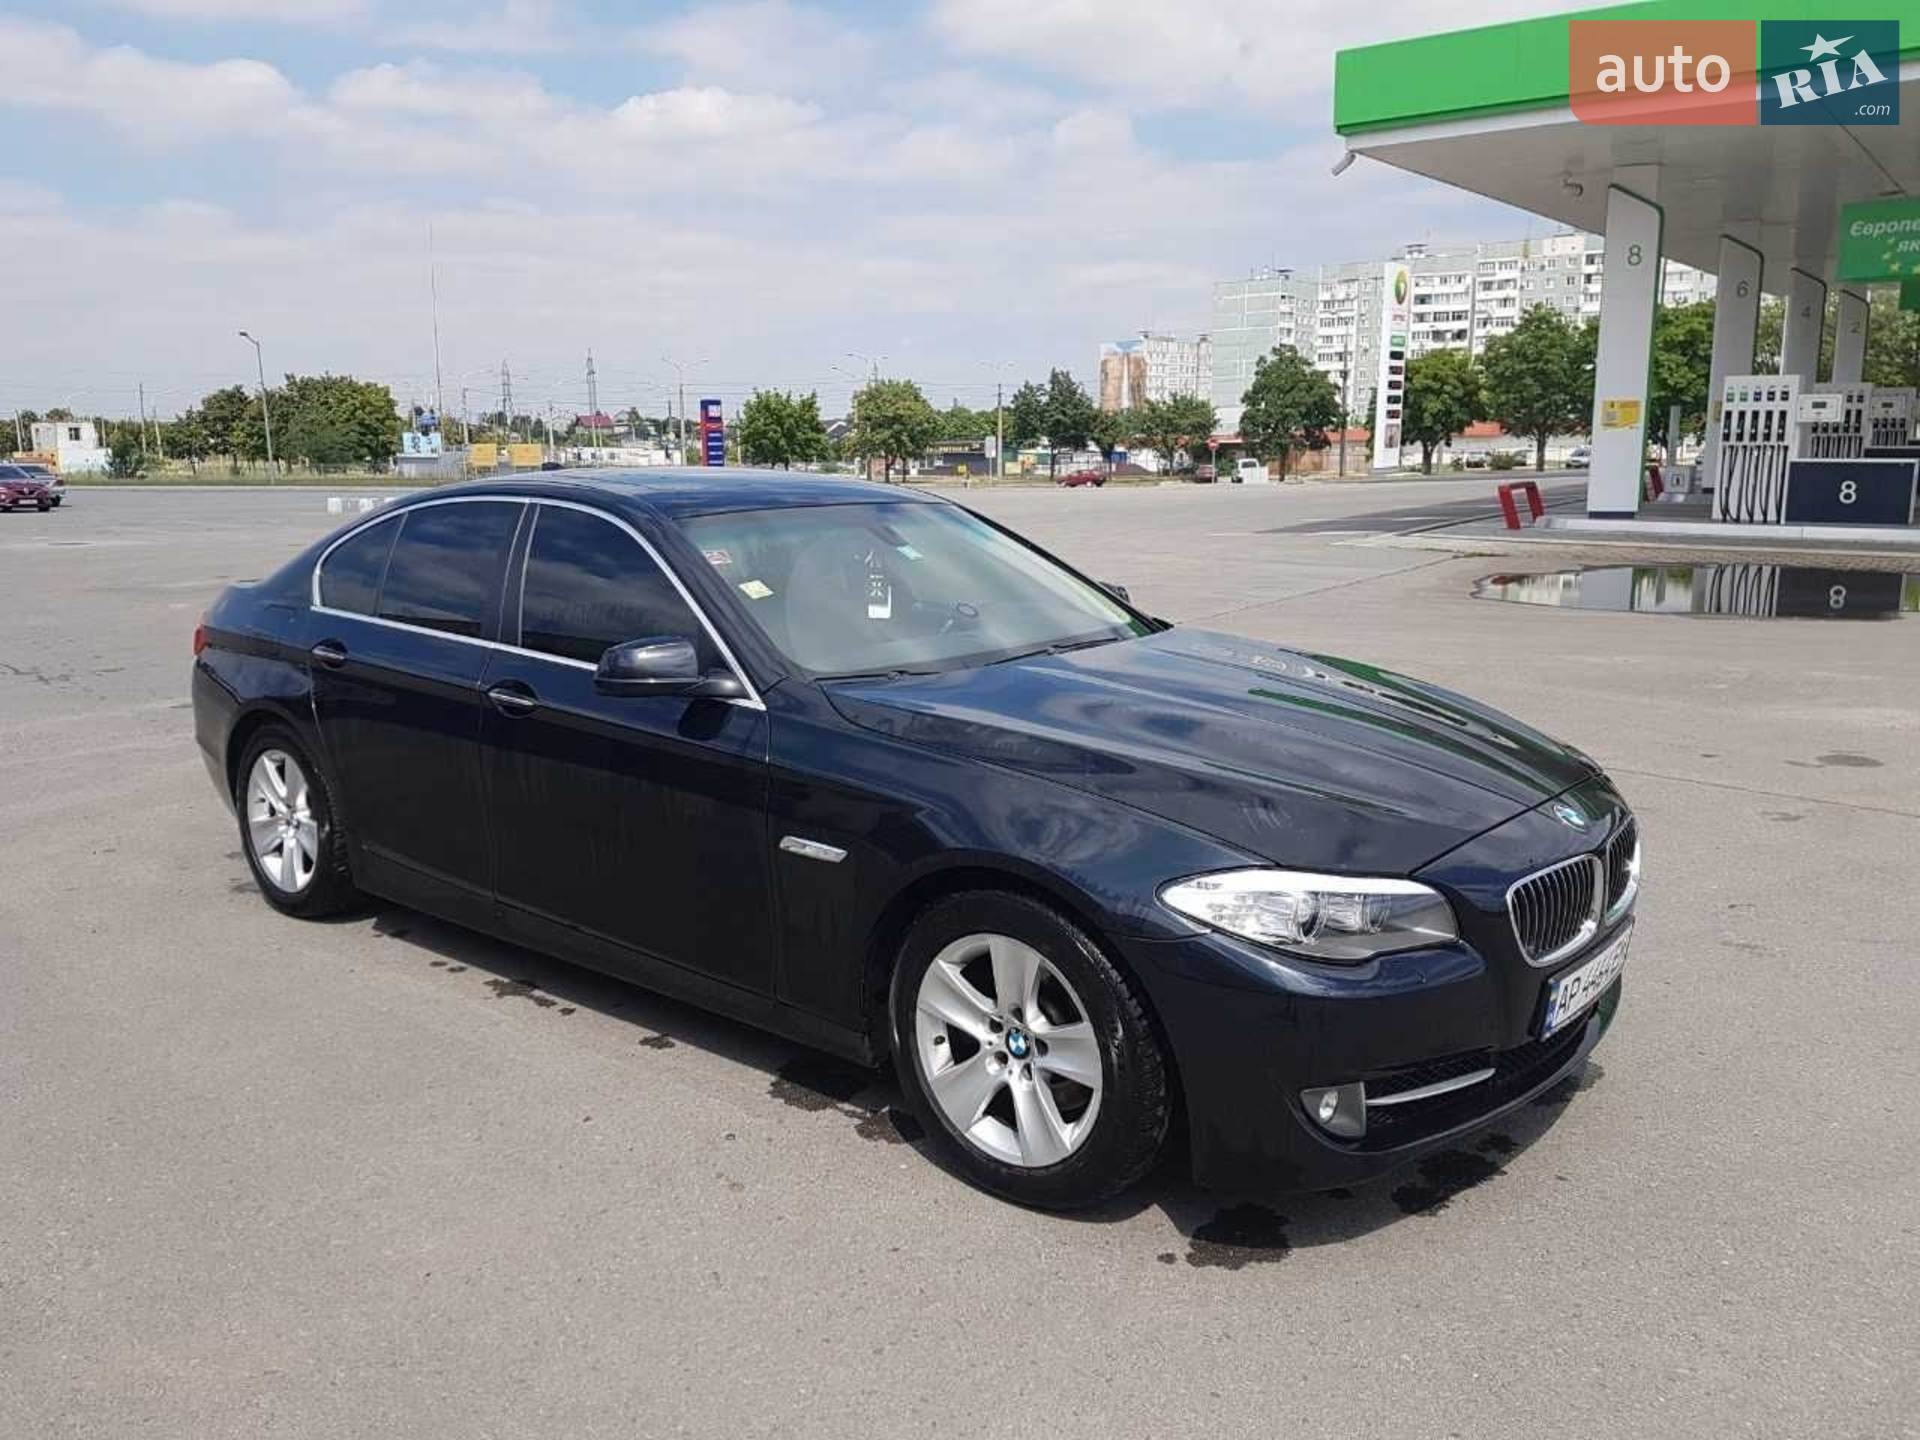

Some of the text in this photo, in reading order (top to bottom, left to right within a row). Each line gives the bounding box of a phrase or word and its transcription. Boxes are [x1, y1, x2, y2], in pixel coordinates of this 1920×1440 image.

[1627, 244, 1642, 266] 8
[1737, 280, 1749, 298] 6
[1838, 480, 1857, 504] 8
[1559, 976, 1581, 1014] AP
